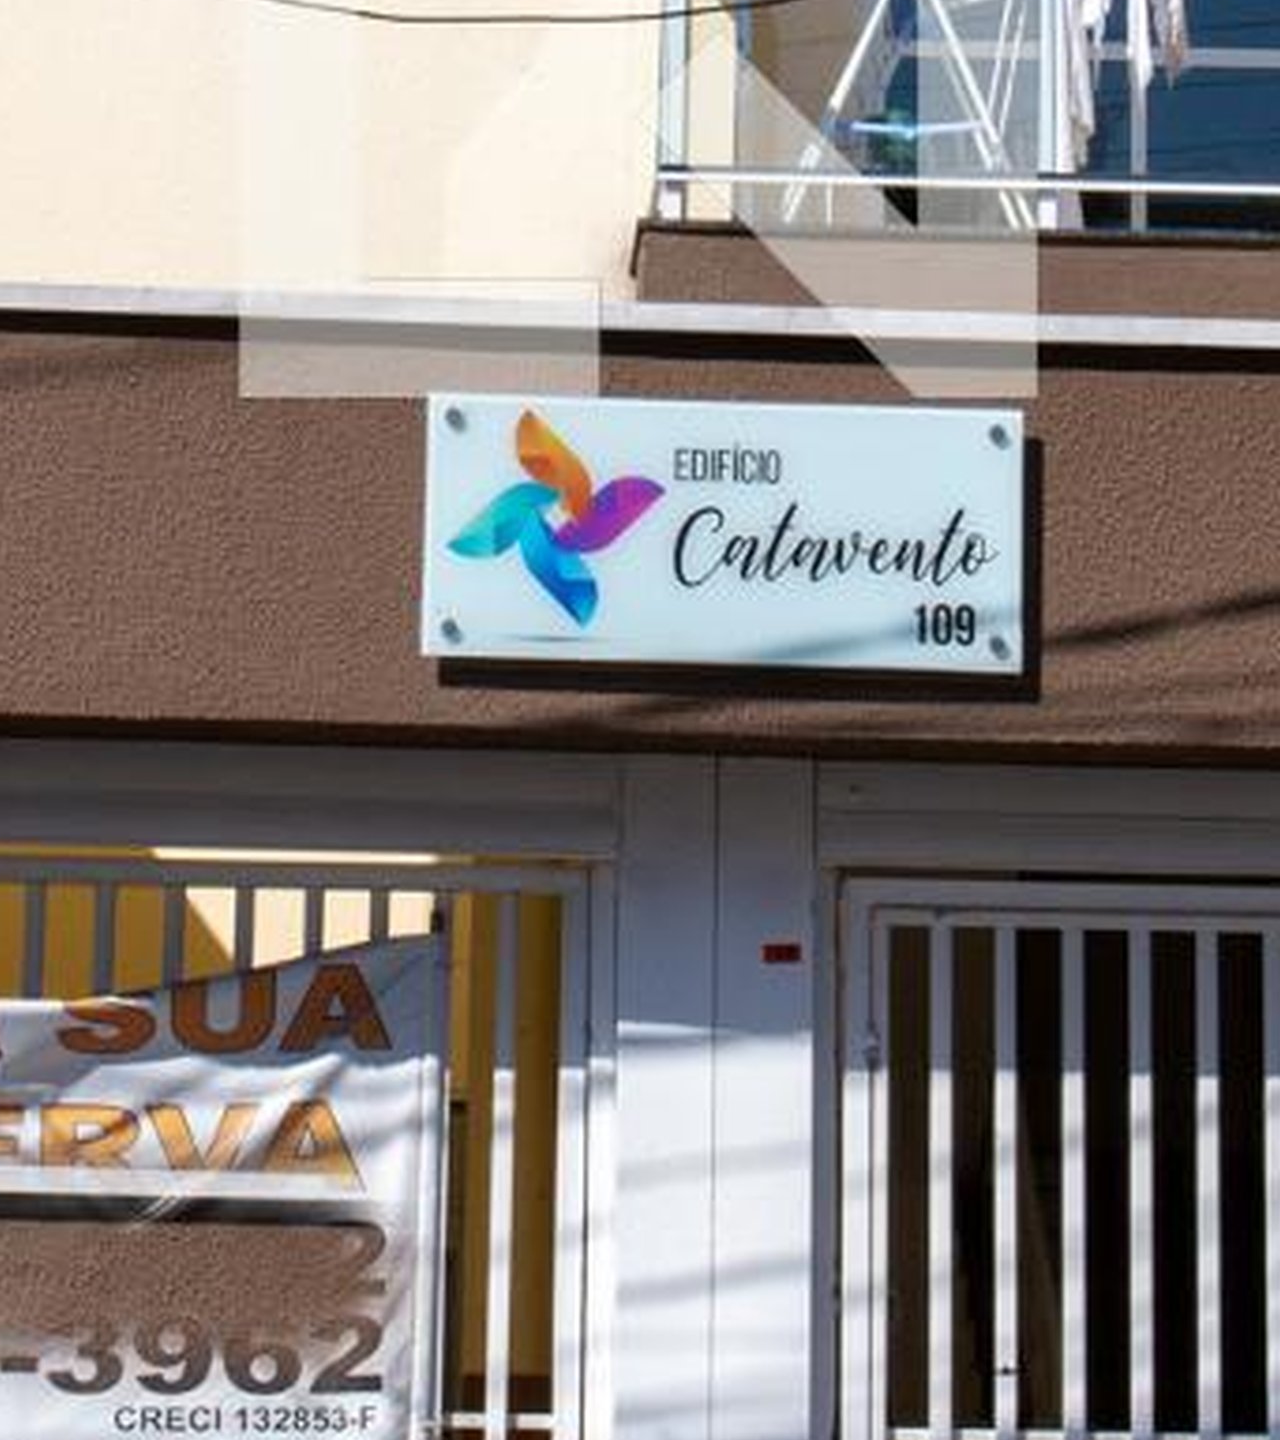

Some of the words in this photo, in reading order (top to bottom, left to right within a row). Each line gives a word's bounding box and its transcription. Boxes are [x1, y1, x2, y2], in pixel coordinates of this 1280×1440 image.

[673, 444, 781, 484] EDIFÍCIO
[673, 503, 997, 588] Catavento
[915, 604, 976, 646] 109
[58, 963, 392, 1054] SUA
[114, 1406, 222, 1433] CRECI
